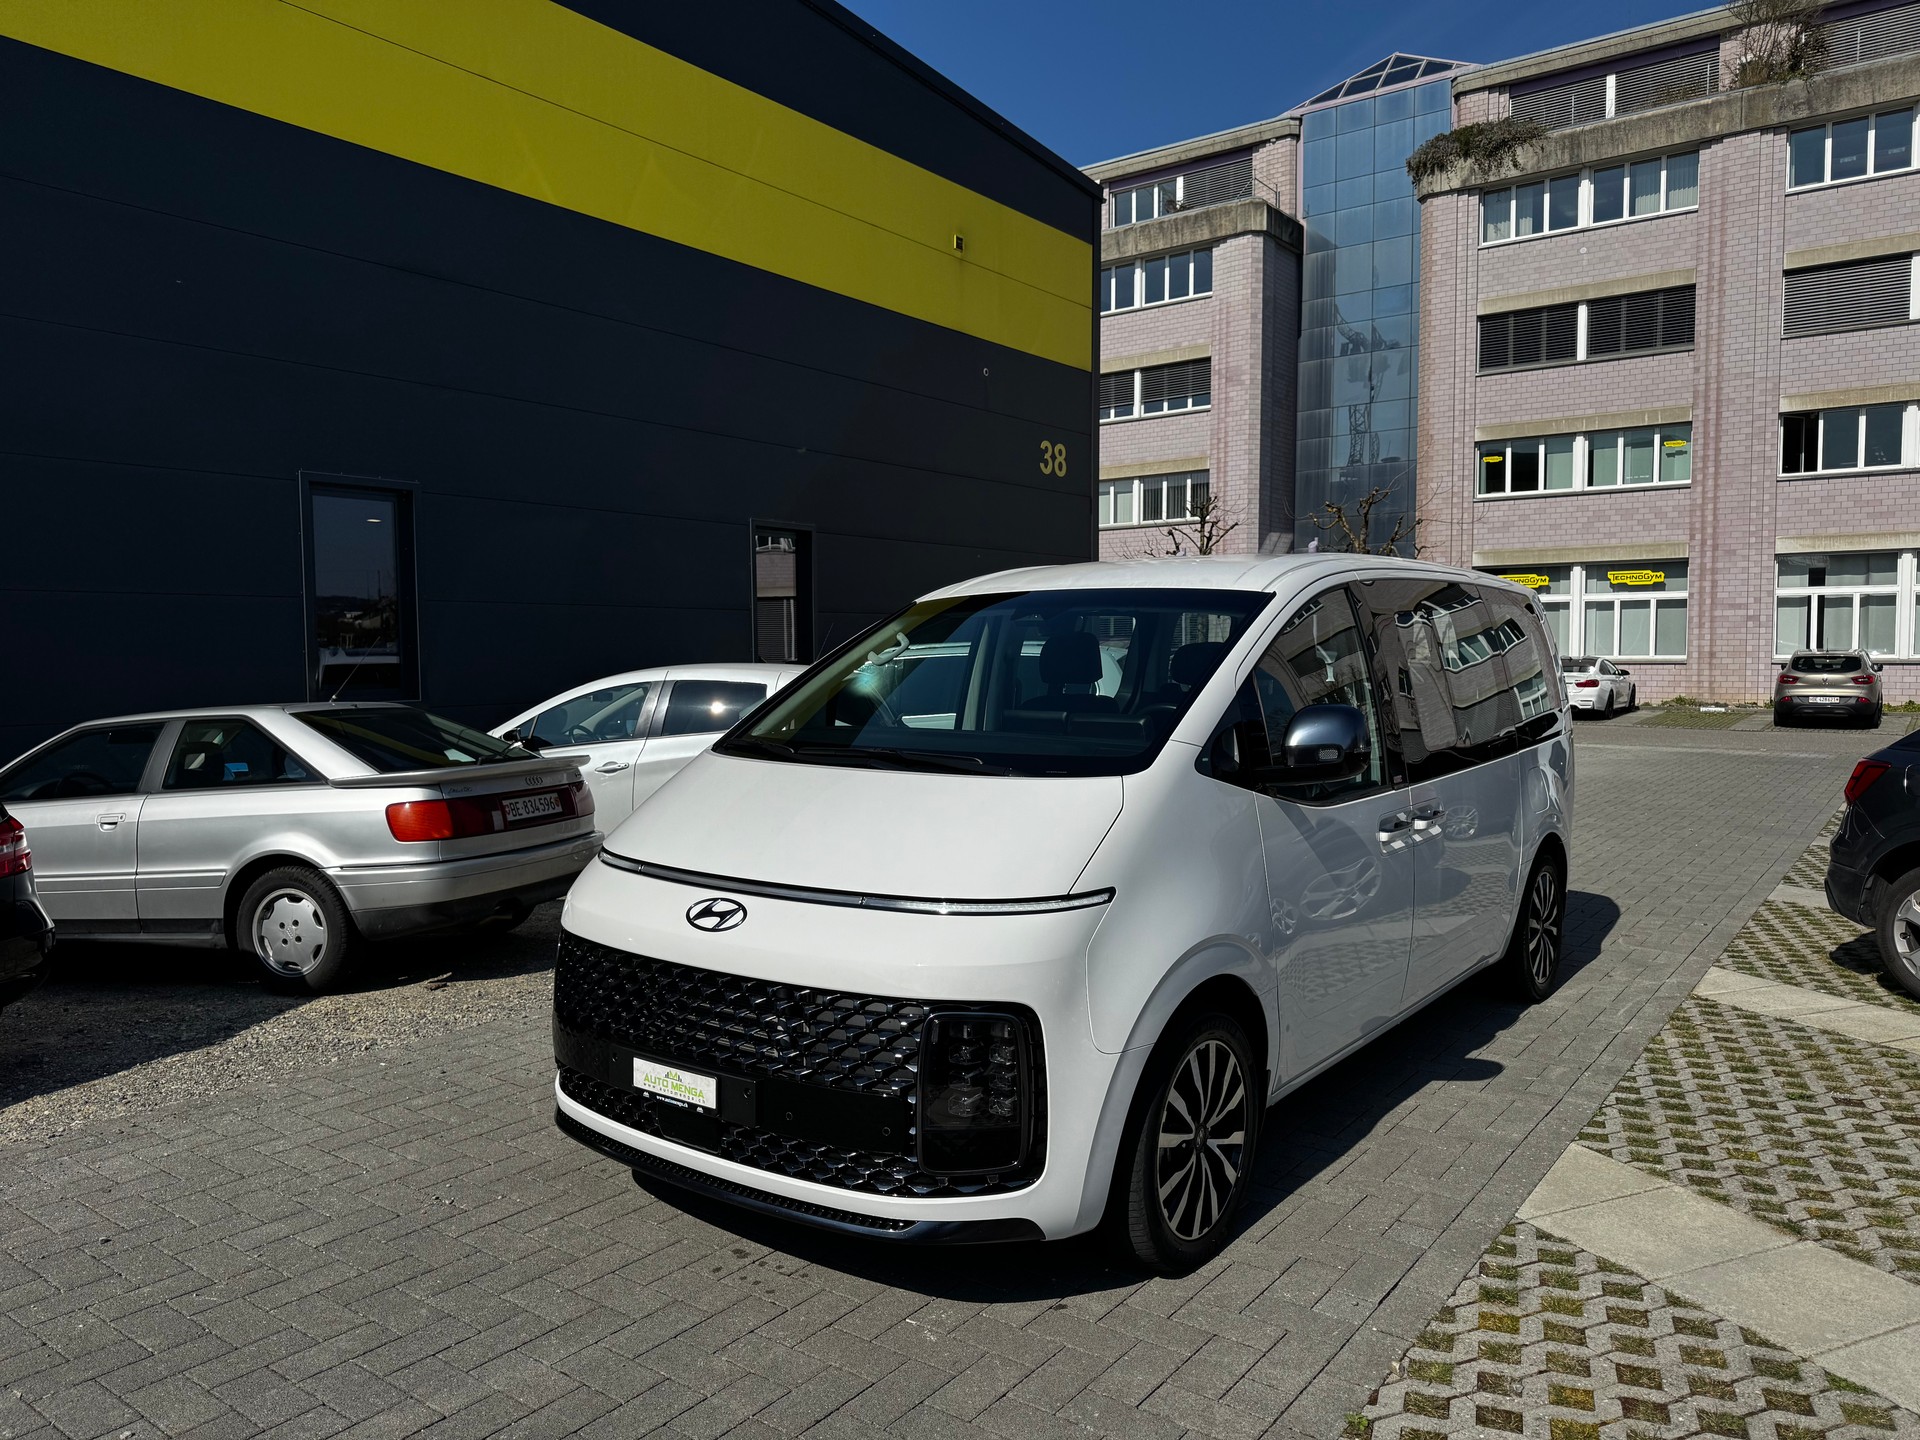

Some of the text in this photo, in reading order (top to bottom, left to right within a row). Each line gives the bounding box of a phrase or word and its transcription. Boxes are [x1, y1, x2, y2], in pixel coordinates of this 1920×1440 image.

[1040, 440, 1067, 477] 38
[643, 1073, 705, 1099] AUTO MENGA
